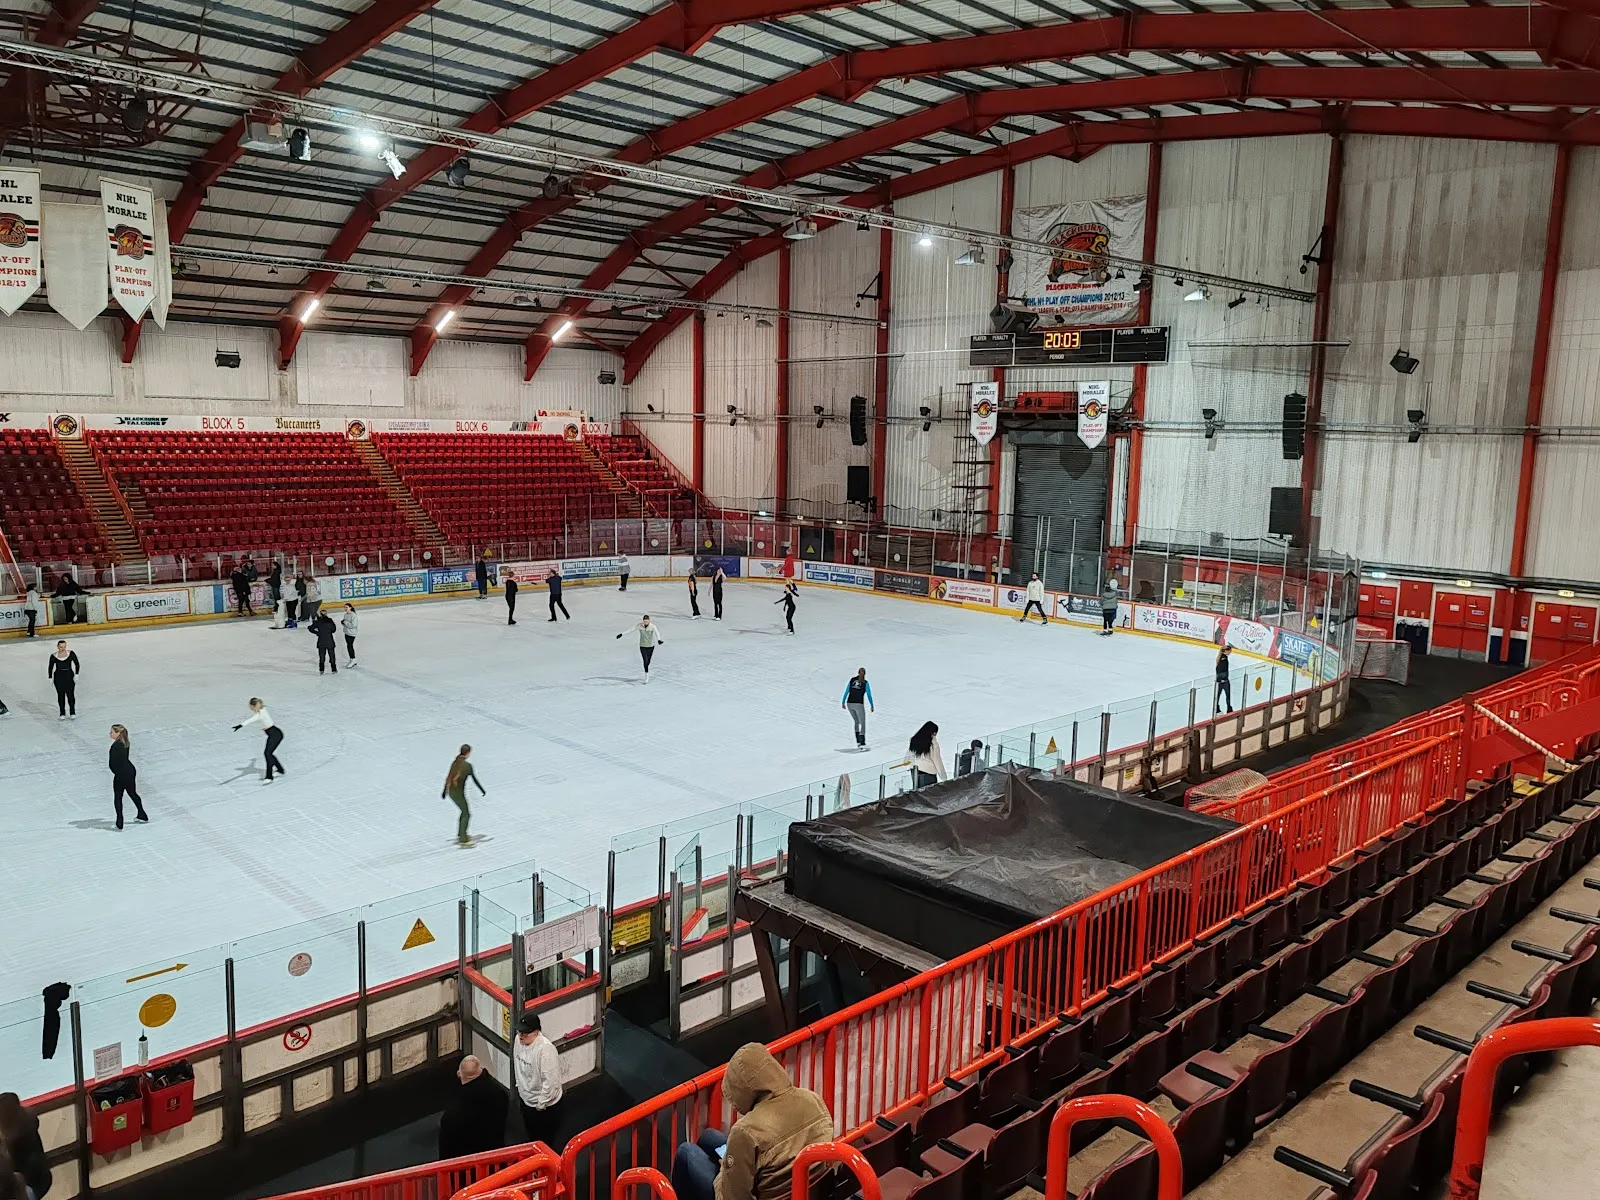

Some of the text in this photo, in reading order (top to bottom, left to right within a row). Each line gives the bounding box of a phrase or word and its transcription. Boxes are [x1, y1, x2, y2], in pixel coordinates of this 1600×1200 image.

[0, 180, 18, 188] HL
[0, 194, 33, 204] ALEE
[116, 193, 138, 205] NIHL
[107, 205, 147, 220] MORALEE
[0, 255, 31, 264] Y-OFF
[120, 288, 145, 297] 2014/15
[1046, 296, 1060, 305] PLAY
[1060, 296, 1071, 304] OFF
[1071, 294, 1104, 304] CHAMPIONS
[1045, 333, 1080, 348] 20:03
[202, 417, 245, 430] BLOCK 5
[275, 417, 321, 430] Buccaneers
[456, 421, 488, 432] BLOCK 6
[582, 424, 609, 434] BLOCK 7
[432, 575, 463, 584] 35 DAYS
[1439, 593, 1446, 601] 7
[133, 596, 182, 610] greenlite
[1086, 599, 1100, 608] 10%
[1538, 604, 1545, 612] 6
[1158, 610, 1178, 620] LETS
[1284, 636, 1306, 652] SKATE
